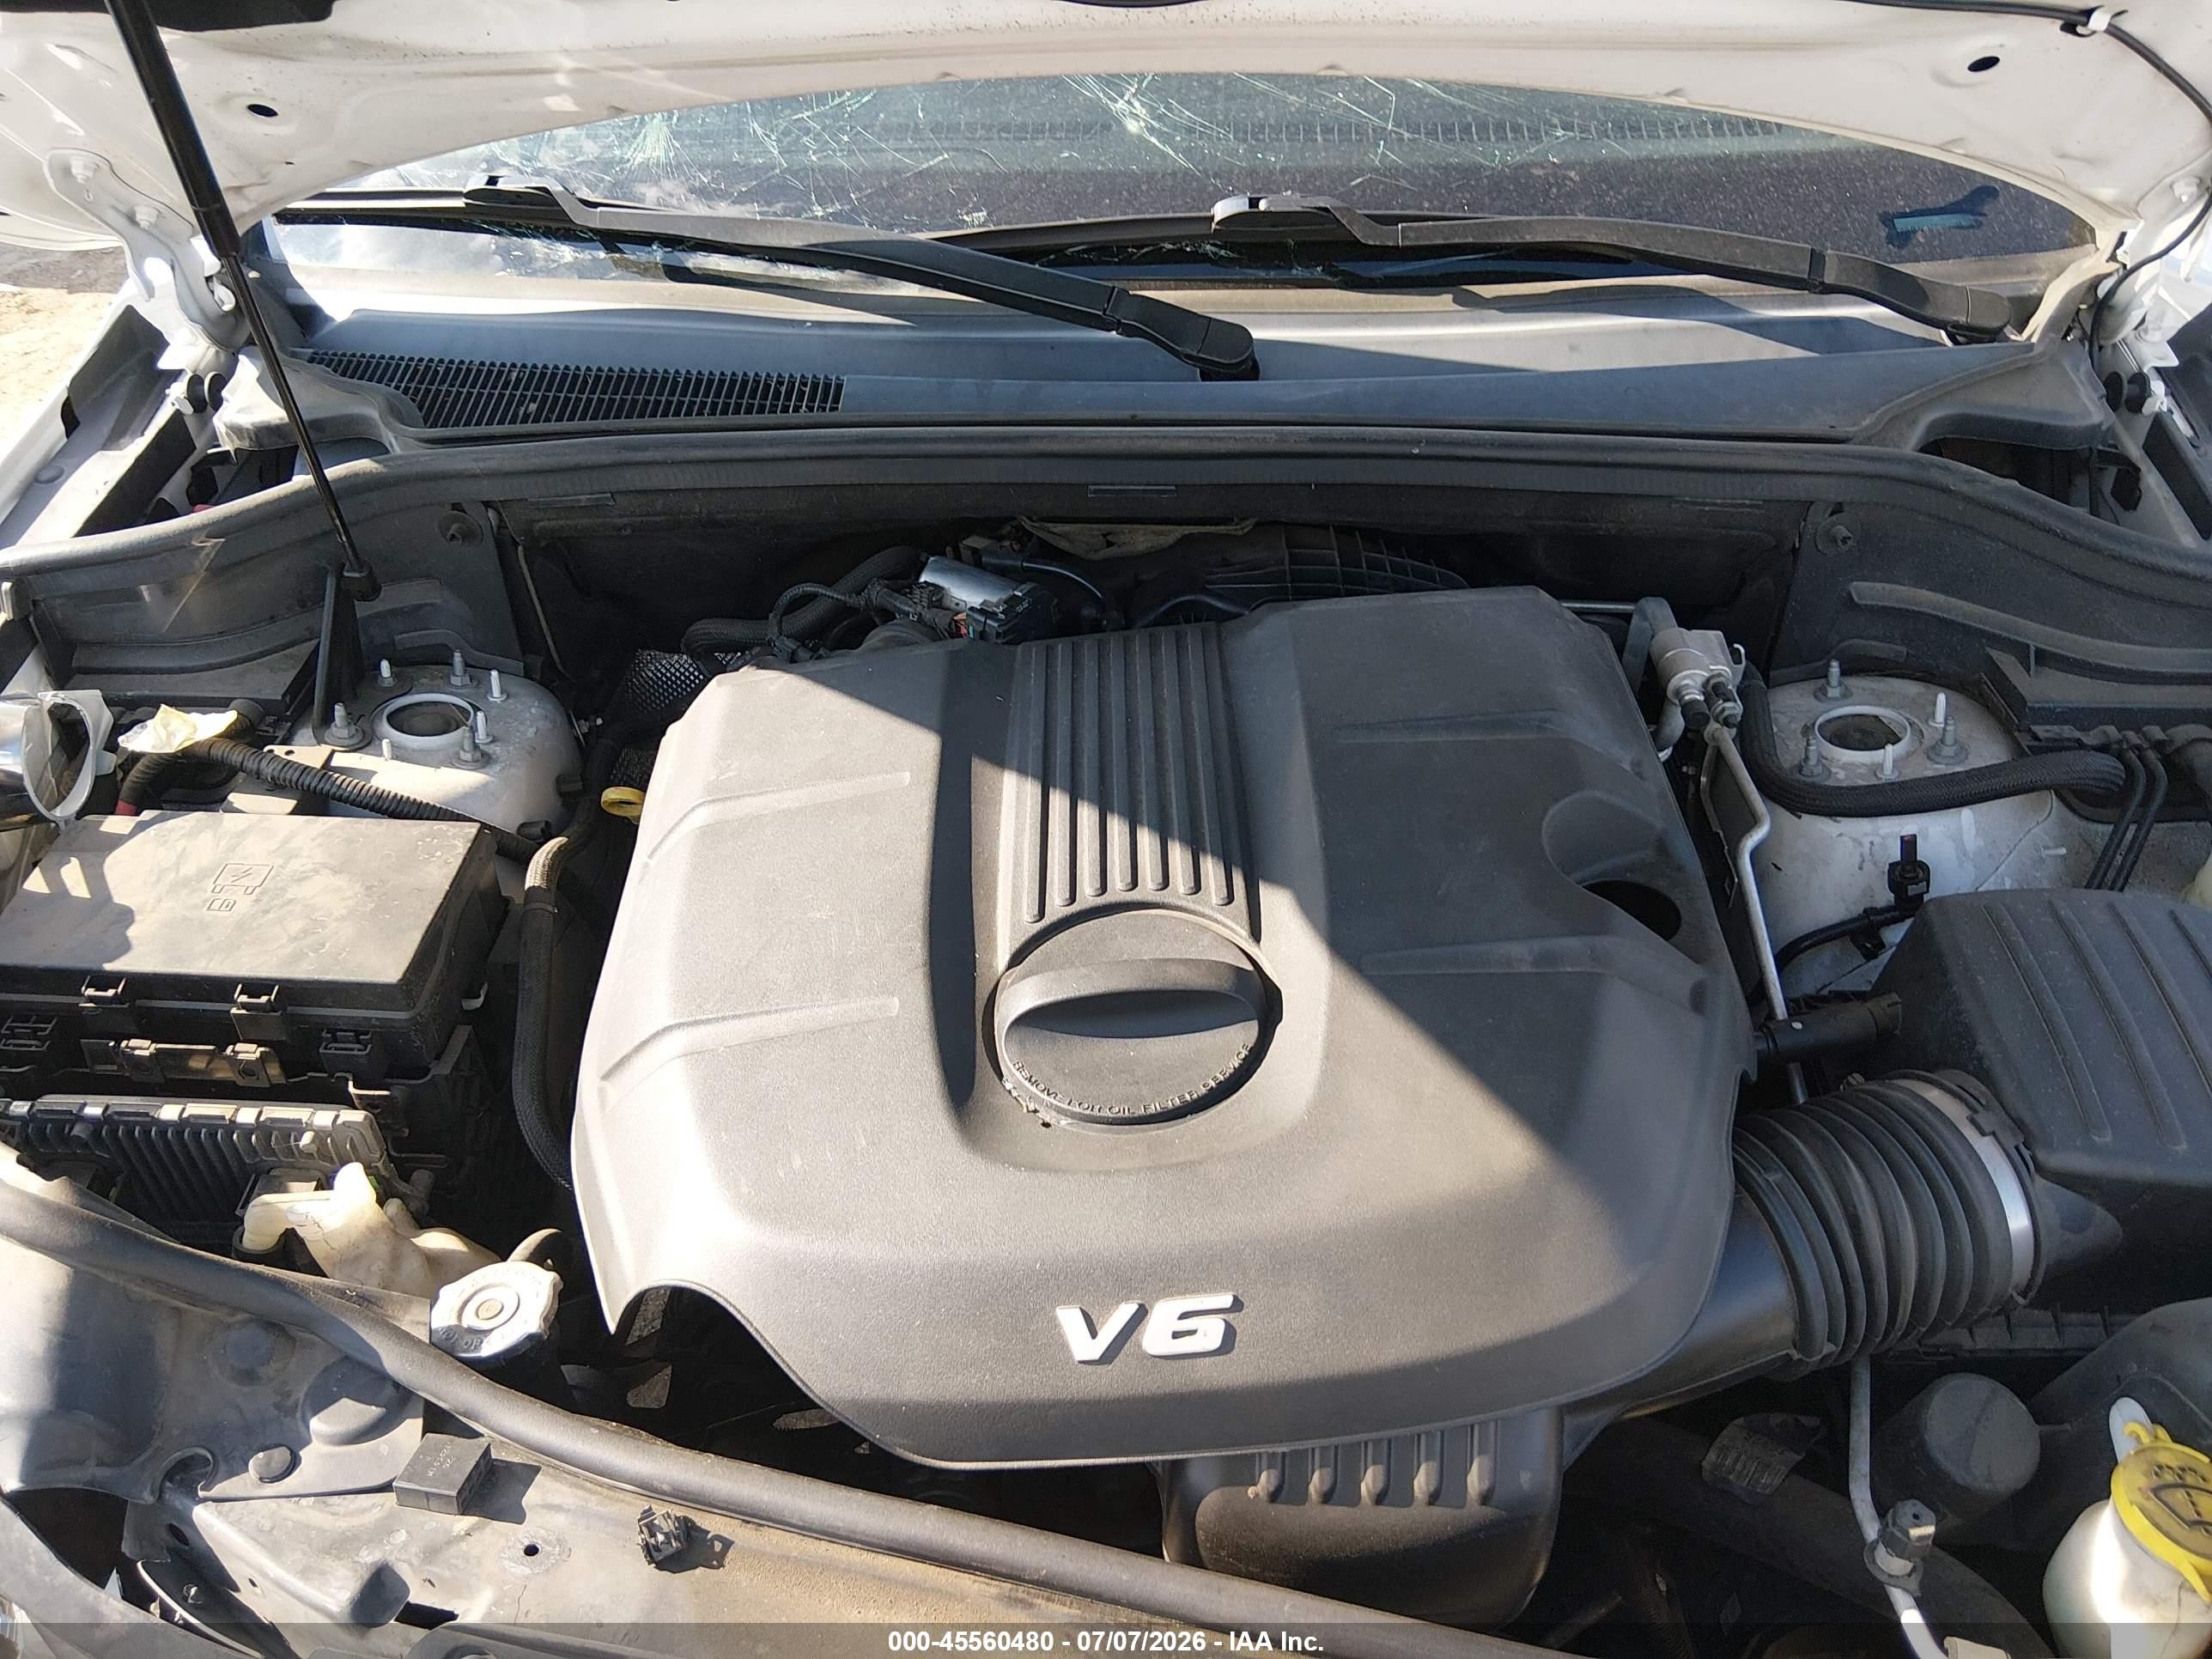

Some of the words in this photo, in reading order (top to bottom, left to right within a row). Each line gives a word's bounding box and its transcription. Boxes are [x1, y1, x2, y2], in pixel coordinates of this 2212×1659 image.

[1012, 1060, 1066, 1103] REMOVE
[1108, 1104, 1136, 1115] OIL
[1140, 1090, 1200, 1115] FILTER
[1201, 1042, 1254, 1095] SERVICE
[1056, 1294, 1244, 1364] V6
